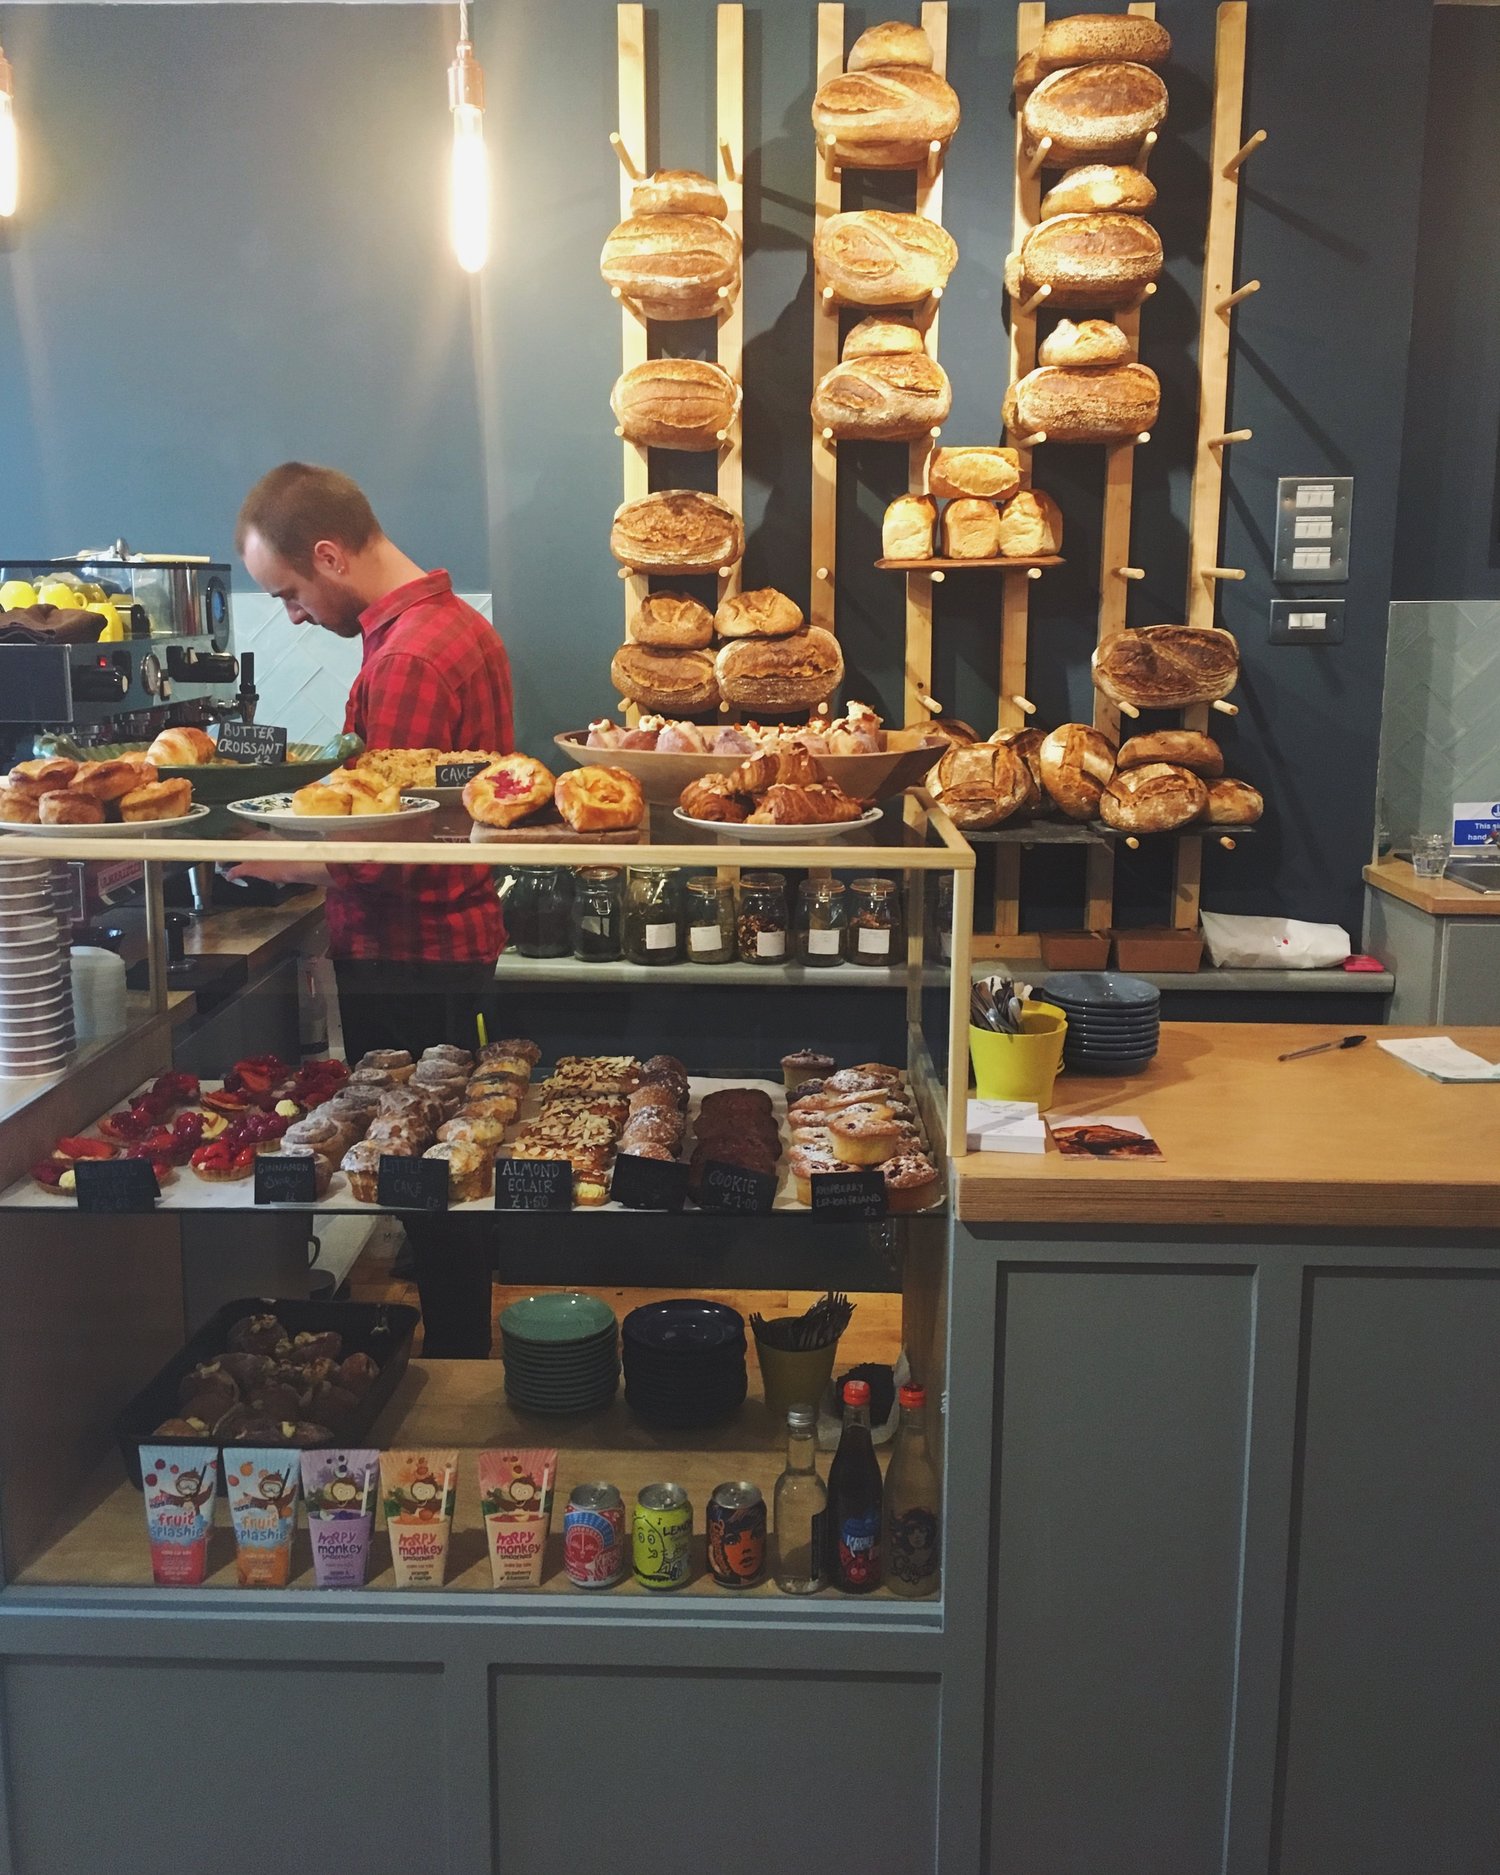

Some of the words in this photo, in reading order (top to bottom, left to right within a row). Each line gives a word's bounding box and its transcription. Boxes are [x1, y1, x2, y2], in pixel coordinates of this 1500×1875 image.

[223, 722, 275, 742] BUTTER
[217, 738, 284, 755] CROISSANT
[440, 766, 475, 782] CAKE
[1474, 822, 1491, 830] This
[1467, 833, 1482, 841] hand
[501, 1160, 560, 1178] ALMOND
[507, 1177, 556, 1193] ECLAIR
[708, 1169, 758, 1196] COOKIE
[158, 1511, 195, 1526] fruit
[242, 1511, 278, 1529] fruit
[150, 1525, 205, 1539] splashie
[317, 1543, 363, 1554] monkey
[398, 1545, 443, 1556] monkey
[496, 1543, 541, 1555] monkey
